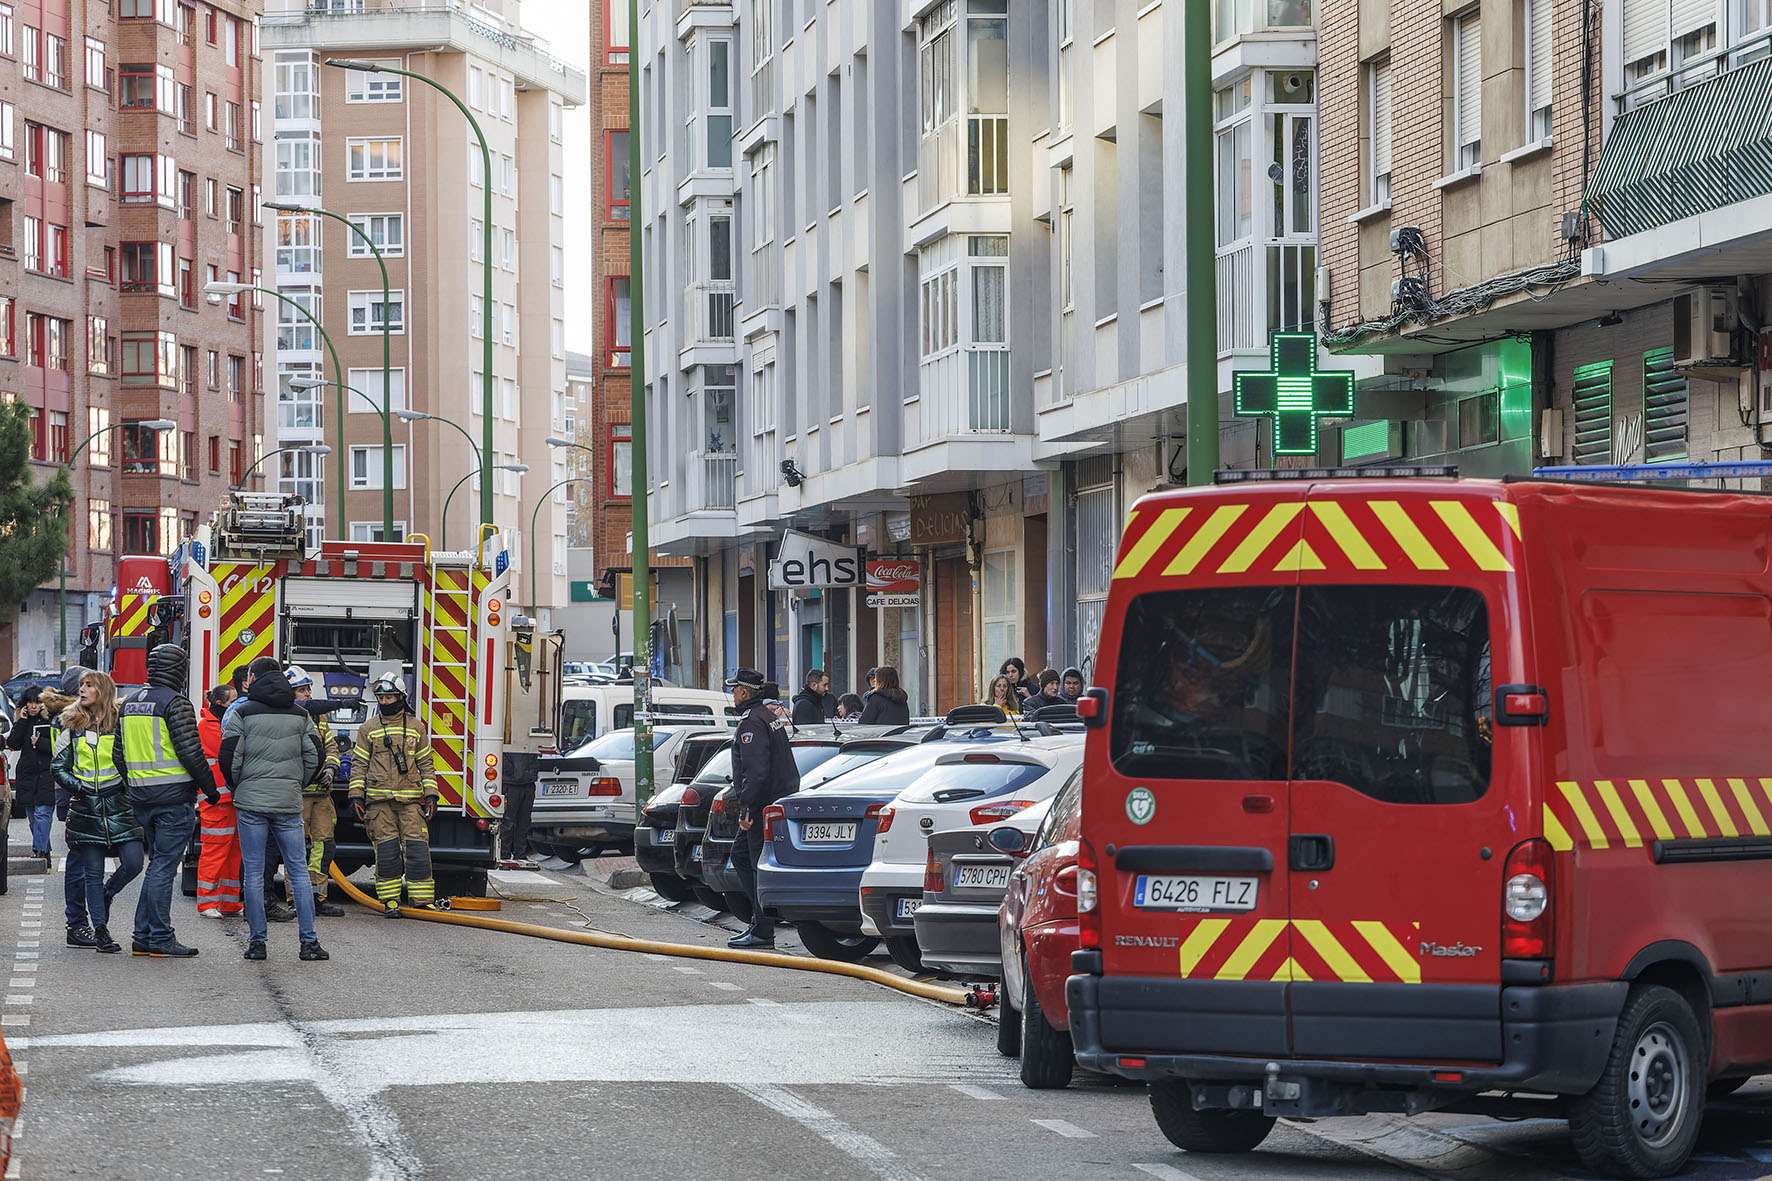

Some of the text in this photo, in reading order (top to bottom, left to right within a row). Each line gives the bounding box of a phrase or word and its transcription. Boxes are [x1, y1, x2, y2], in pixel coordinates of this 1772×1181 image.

[782, 550, 857, 585] ehs
[866, 597, 920, 606] CAFE DELICIAS
[808, 826, 854, 839] 3394 JLY
[960, 868, 1006, 885] 5780 CPH
[1151, 880, 1199, 903] 6426
[1212, 881, 1251, 905] FLZ
[1115, 936, 1179, 948] RENAULT
[1420, 941, 1482, 957] Master
